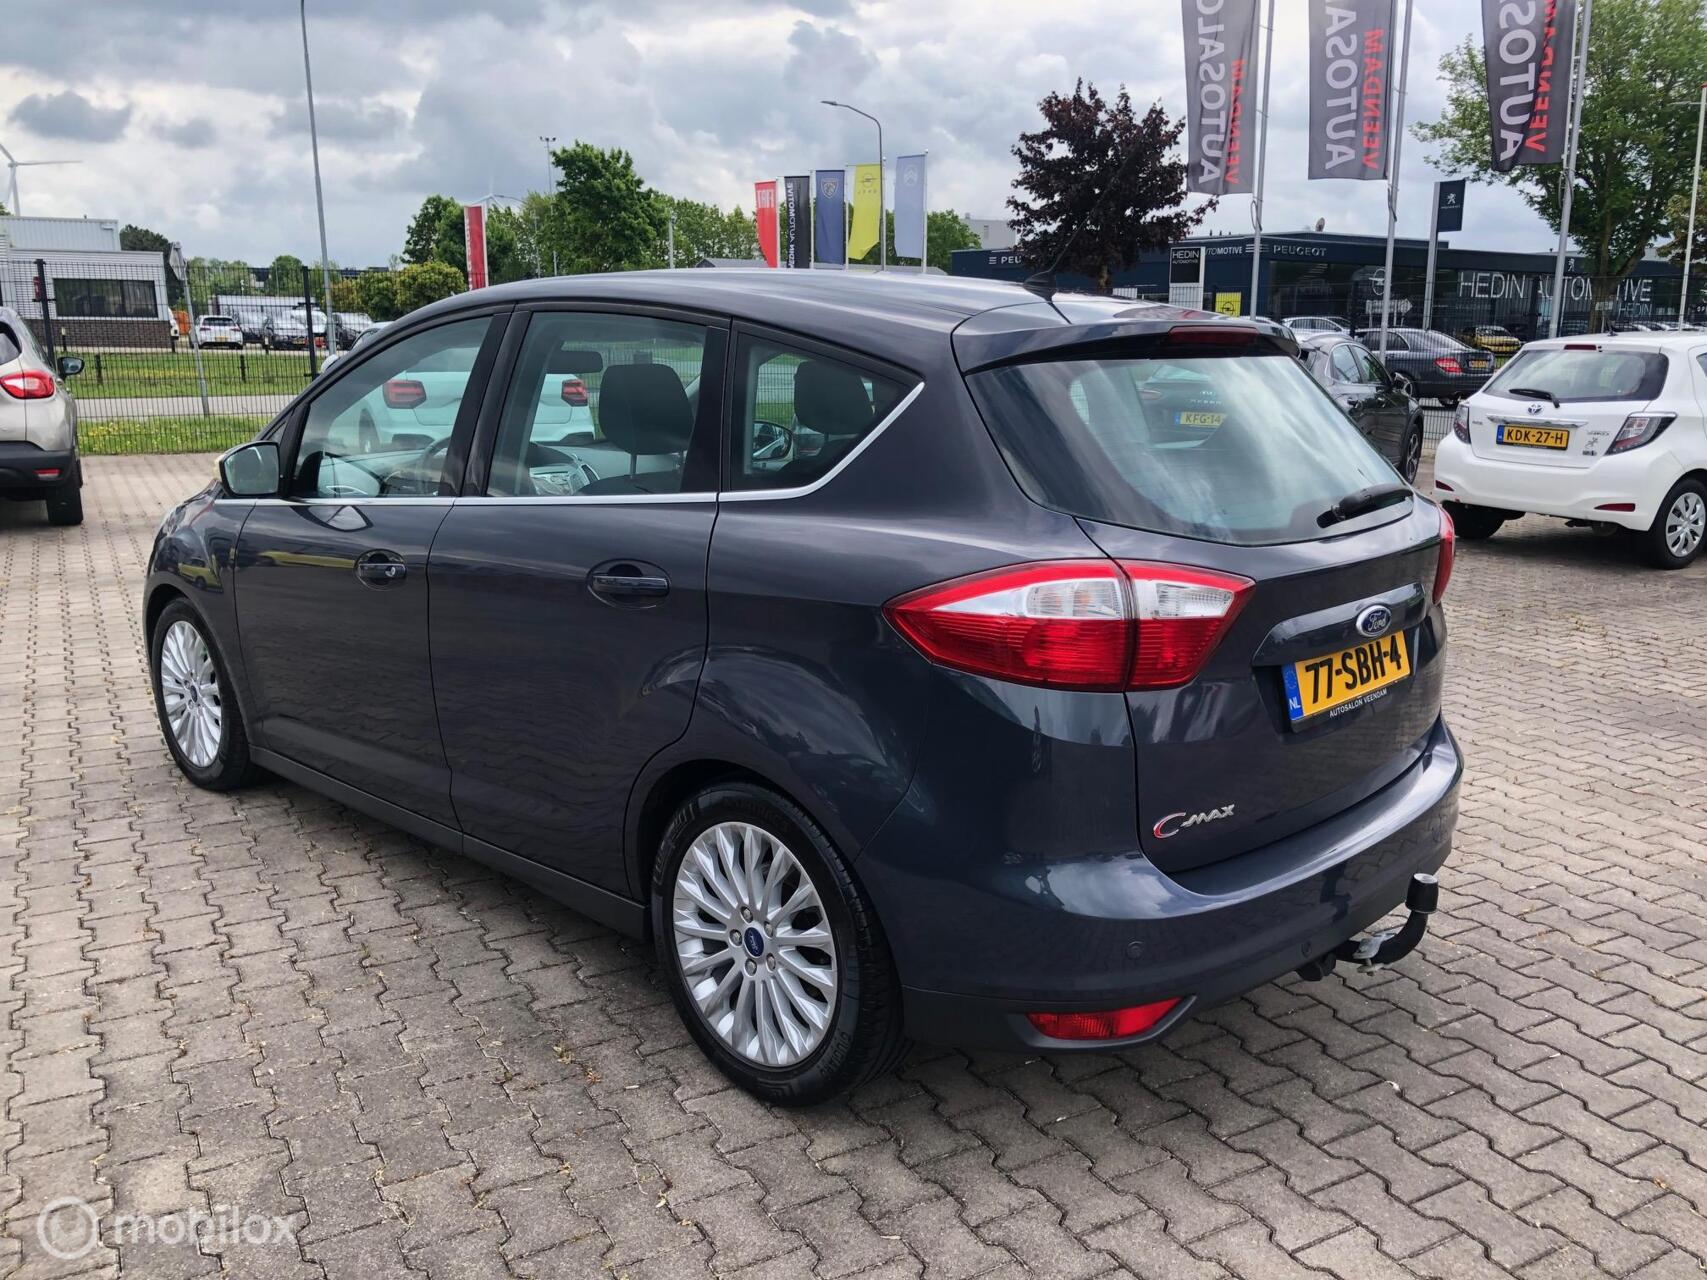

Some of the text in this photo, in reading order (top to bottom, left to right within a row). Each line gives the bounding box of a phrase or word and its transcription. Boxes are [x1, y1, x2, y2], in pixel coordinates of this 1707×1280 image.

[1172, 250, 1199, 259] HEDIN
[1273, 245, 1327, 256] PEUGEOT
[1459, 272, 1526, 299] HEDIN
[1507, 428, 1563, 445] KDK-27-H
[1367, 611, 1388, 631] Ford
[1305, 635, 1402, 704] 77-SBH-4
[1289, 697, 1301, 710] NL
[1329, 688, 1388, 718] AUTOSALON VEENDAM
